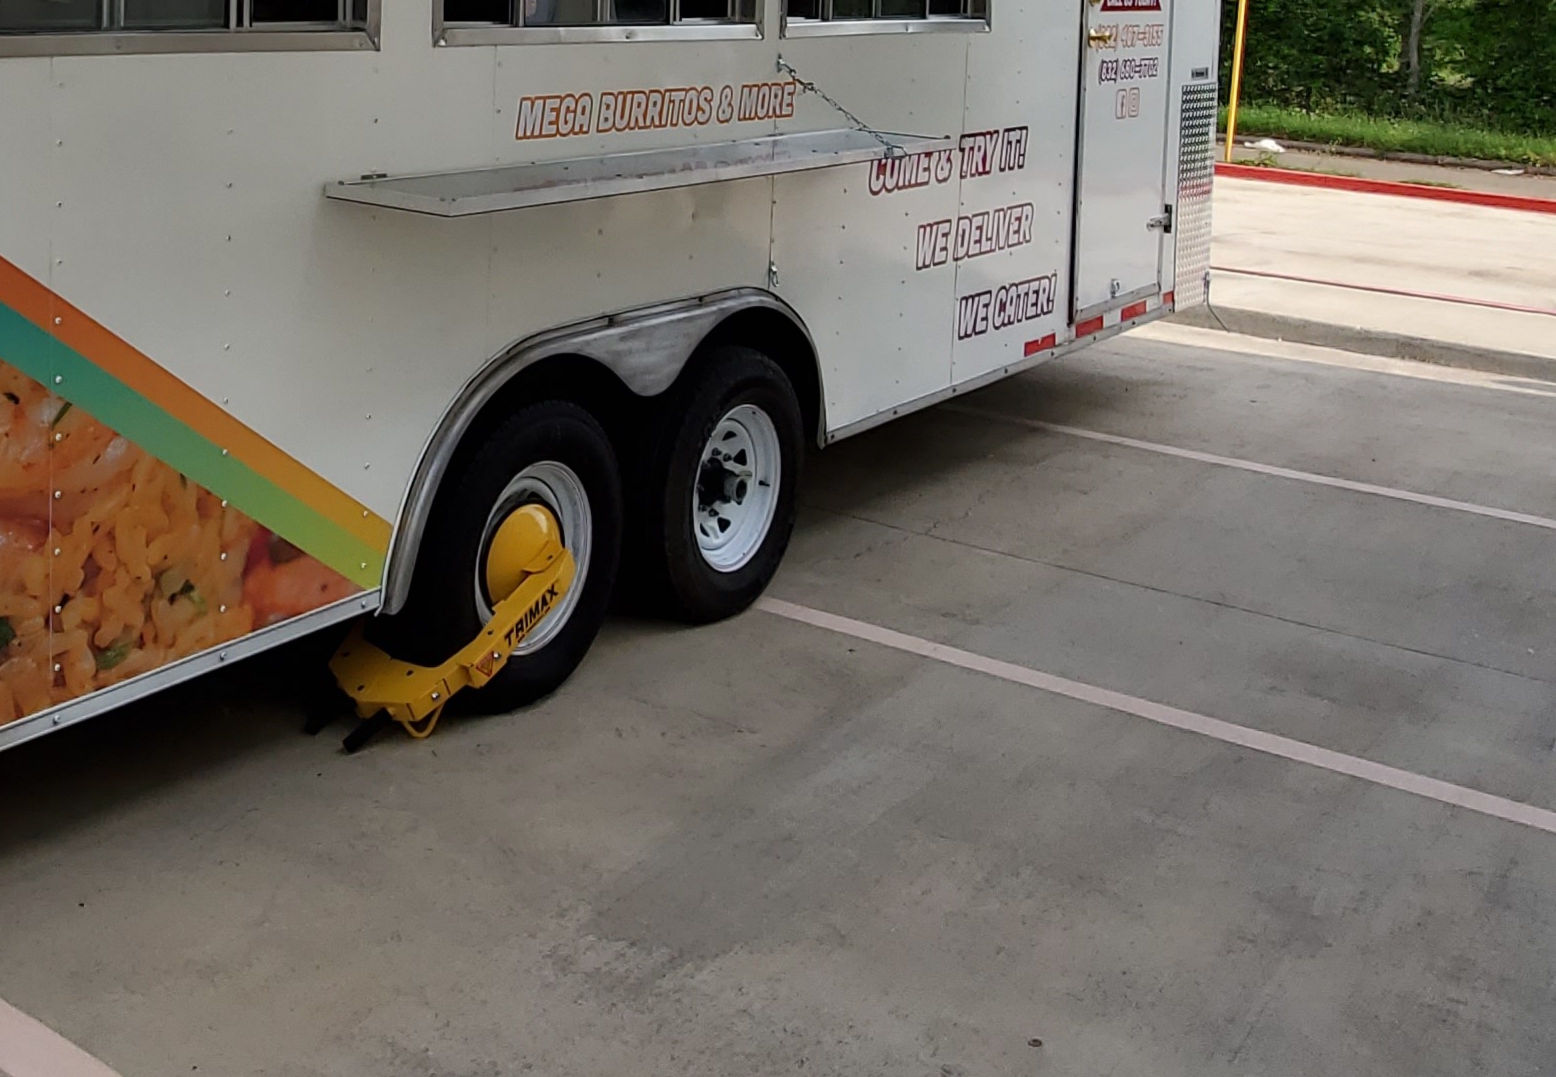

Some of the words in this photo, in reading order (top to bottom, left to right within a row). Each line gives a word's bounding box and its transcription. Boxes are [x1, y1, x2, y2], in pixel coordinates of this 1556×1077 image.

[515, 90, 593, 140] MEGA
[597, 86, 716, 133] BURRITOS
[717, 84, 735, 124] &
[737, 80, 798, 123] MORE
[869, 150, 931, 196] COME
[934, 149, 953, 185] &
[959, 130, 1000, 180] TRY
[999, 126, 1029, 173] IT!
[916, 219, 953, 271] WE
[953, 203, 1035, 263] DELIVER
[958, 290, 992, 341] WE
[992, 274, 1058, 330] CATER!
[503, 583, 559, 648] TRIMAX
